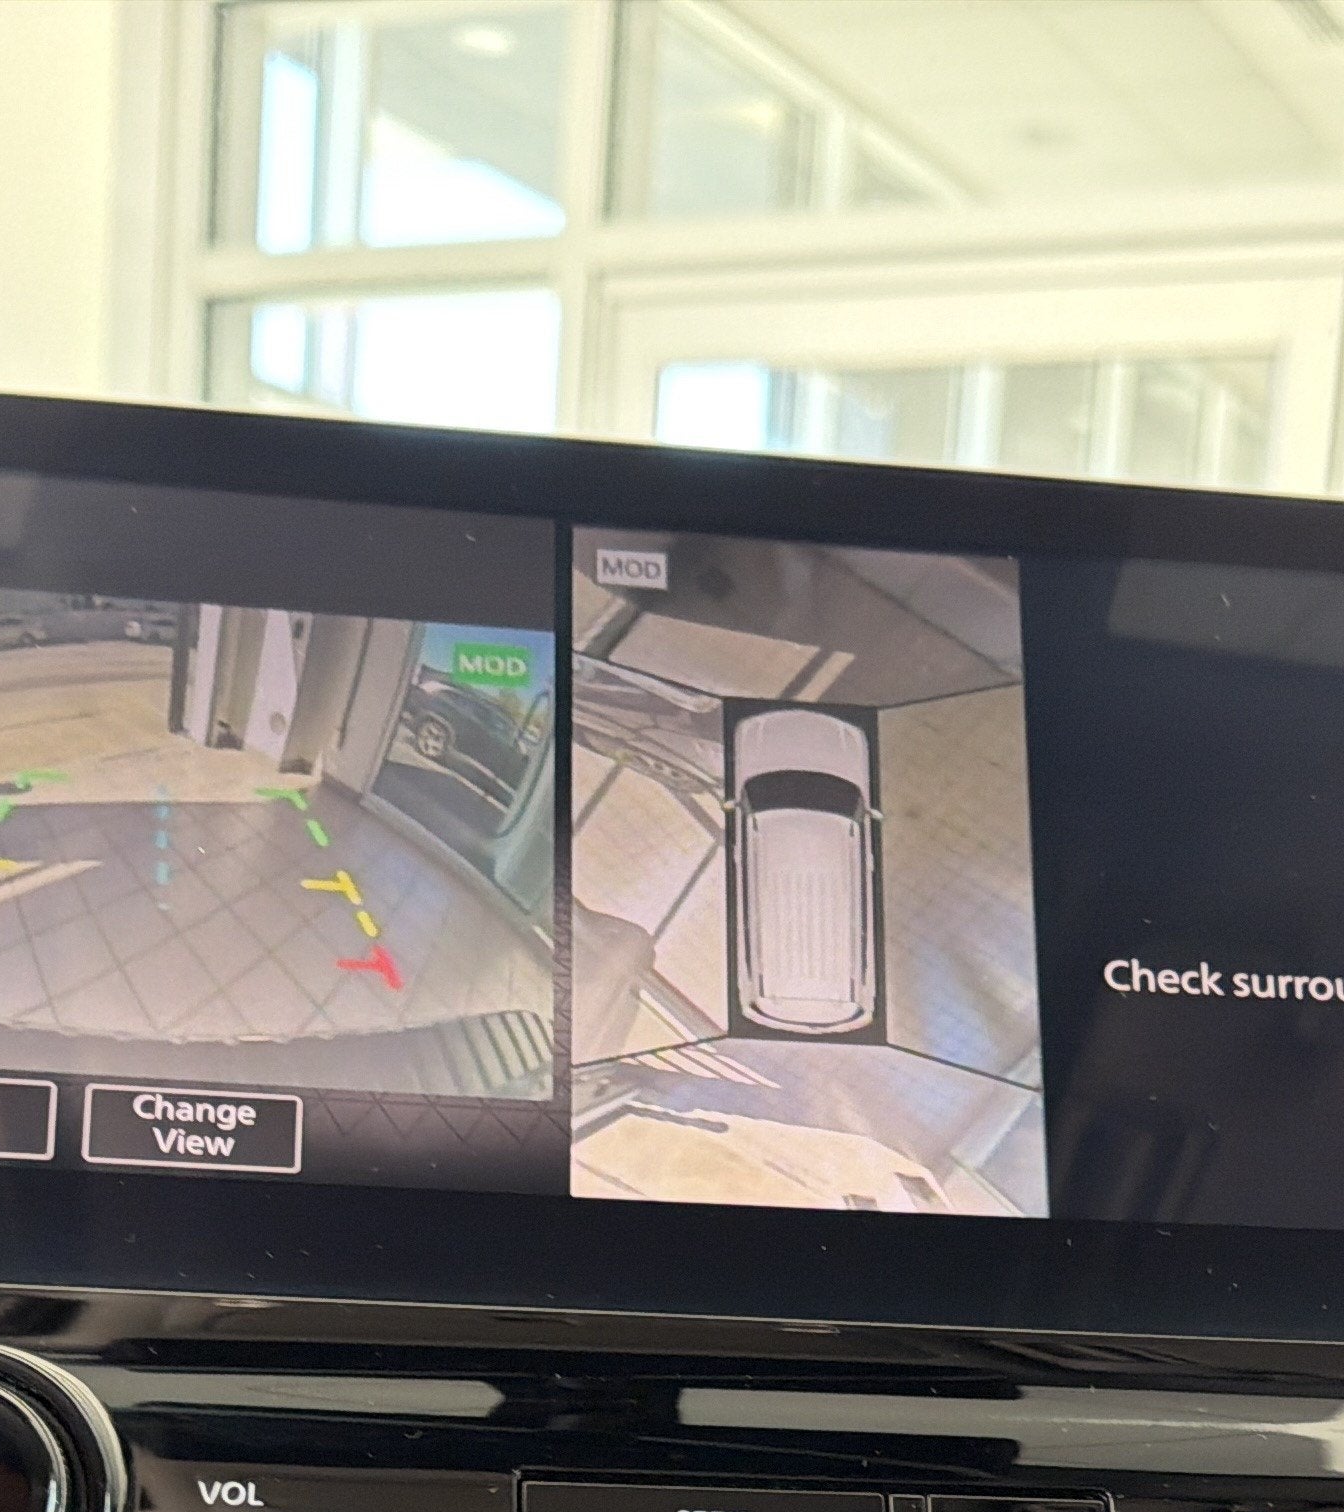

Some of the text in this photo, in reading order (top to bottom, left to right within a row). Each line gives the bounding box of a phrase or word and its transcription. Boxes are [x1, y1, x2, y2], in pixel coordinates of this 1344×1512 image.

[600, 556, 662, 582] MOD
[458, 651, 528, 680] MOD
[1103, 958, 1225, 998] Check
[131, 1092, 258, 1133] Change
[152, 1126, 237, 1158] View
[197, 1480, 265, 1508] VOL
